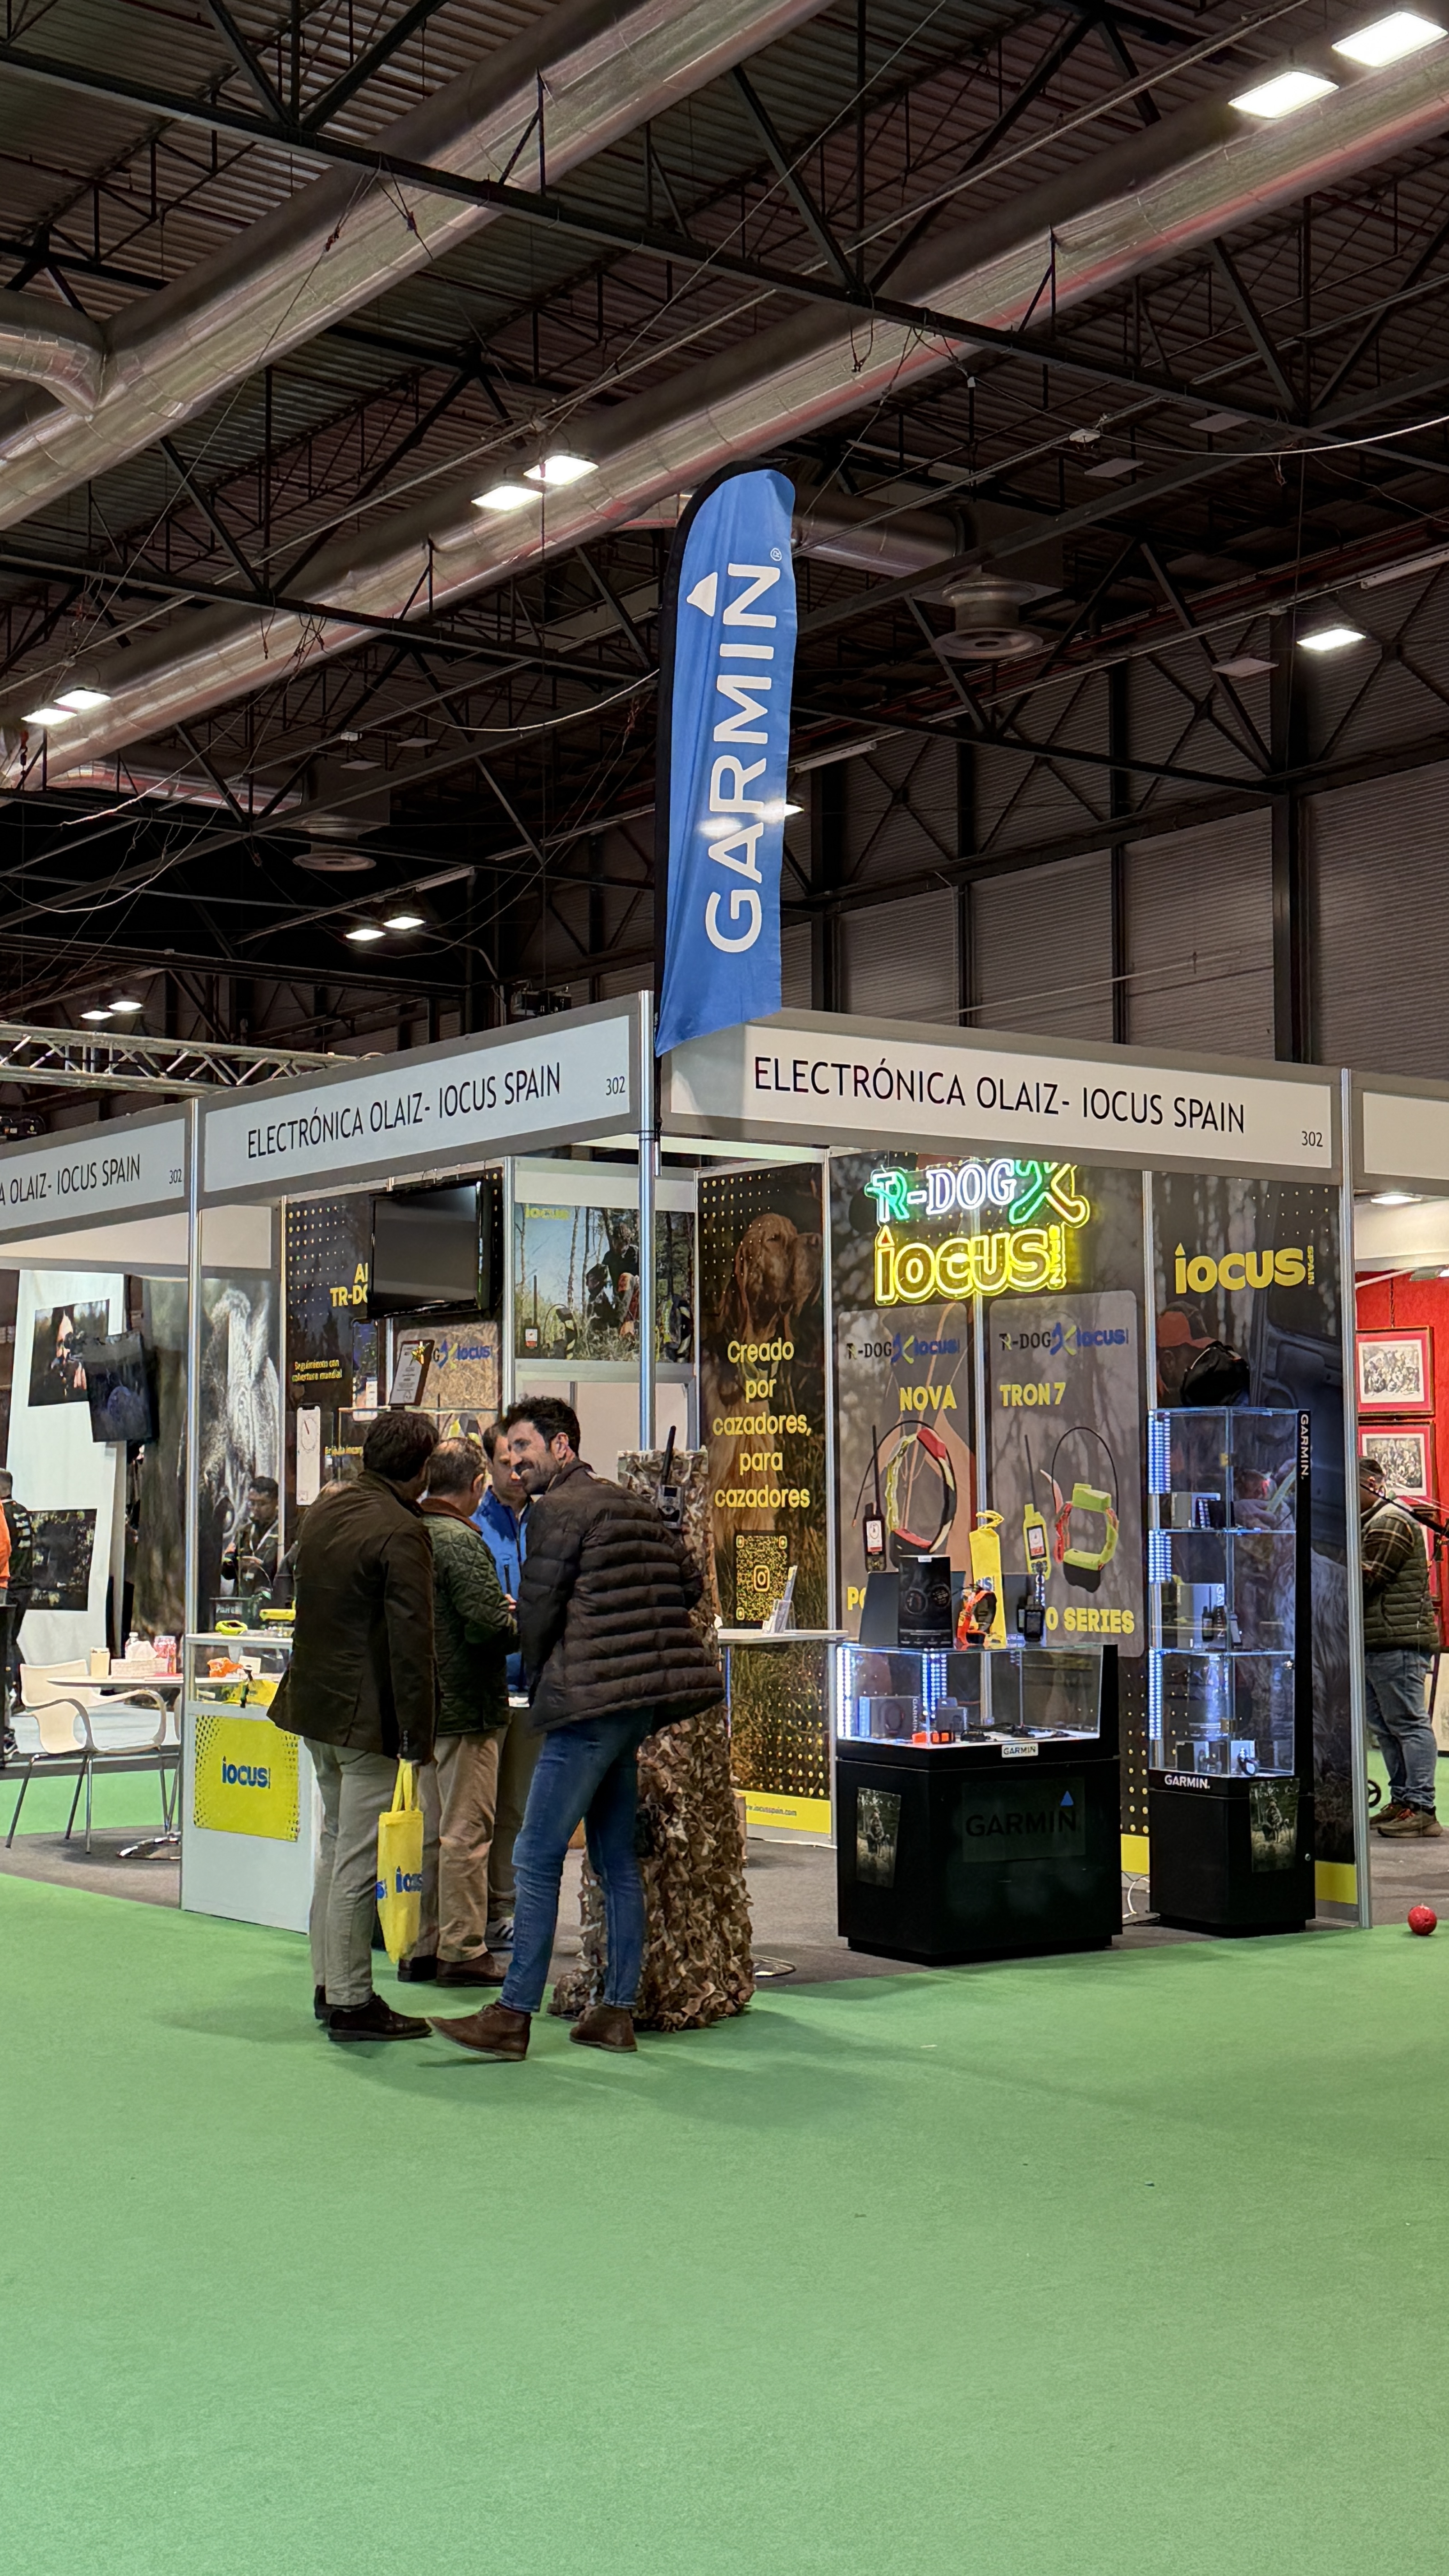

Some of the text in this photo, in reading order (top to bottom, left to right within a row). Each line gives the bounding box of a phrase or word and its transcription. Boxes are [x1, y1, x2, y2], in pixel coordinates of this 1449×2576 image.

[606, 1076, 626, 1096] 302
[755, 1057, 1244, 1134] ELECTRÓNICA OLAIZ- IOCUS SPAIN
[248, 1062, 560, 1159] ELECTRÓNICA OLAIZ- IOCUS SPAIN
[1301, 1131, 1323, 1147] 302
[57, 1162, 97, 1195] IOCUS
[102, 1154, 140, 1187] SPAIN
[169, 1169, 182, 1184] 302
[727, 1337, 794, 1363] Creado
[745, 1379, 777, 1403] por
[900, 1385, 957, 1411] NOVA
[999, 1382, 1066, 1407] TRON 7
[713, 1412, 811, 1436] cazadores,
[740, 1452, 783, 1476] para
[715, 1484, 810, 1508] cazadores
[1063, 1607, 1135, 1634] SERIES
[1003, 1746, 1036, 1756] GARMIN
[966, 1810, 1076, 1837] GARMIN
